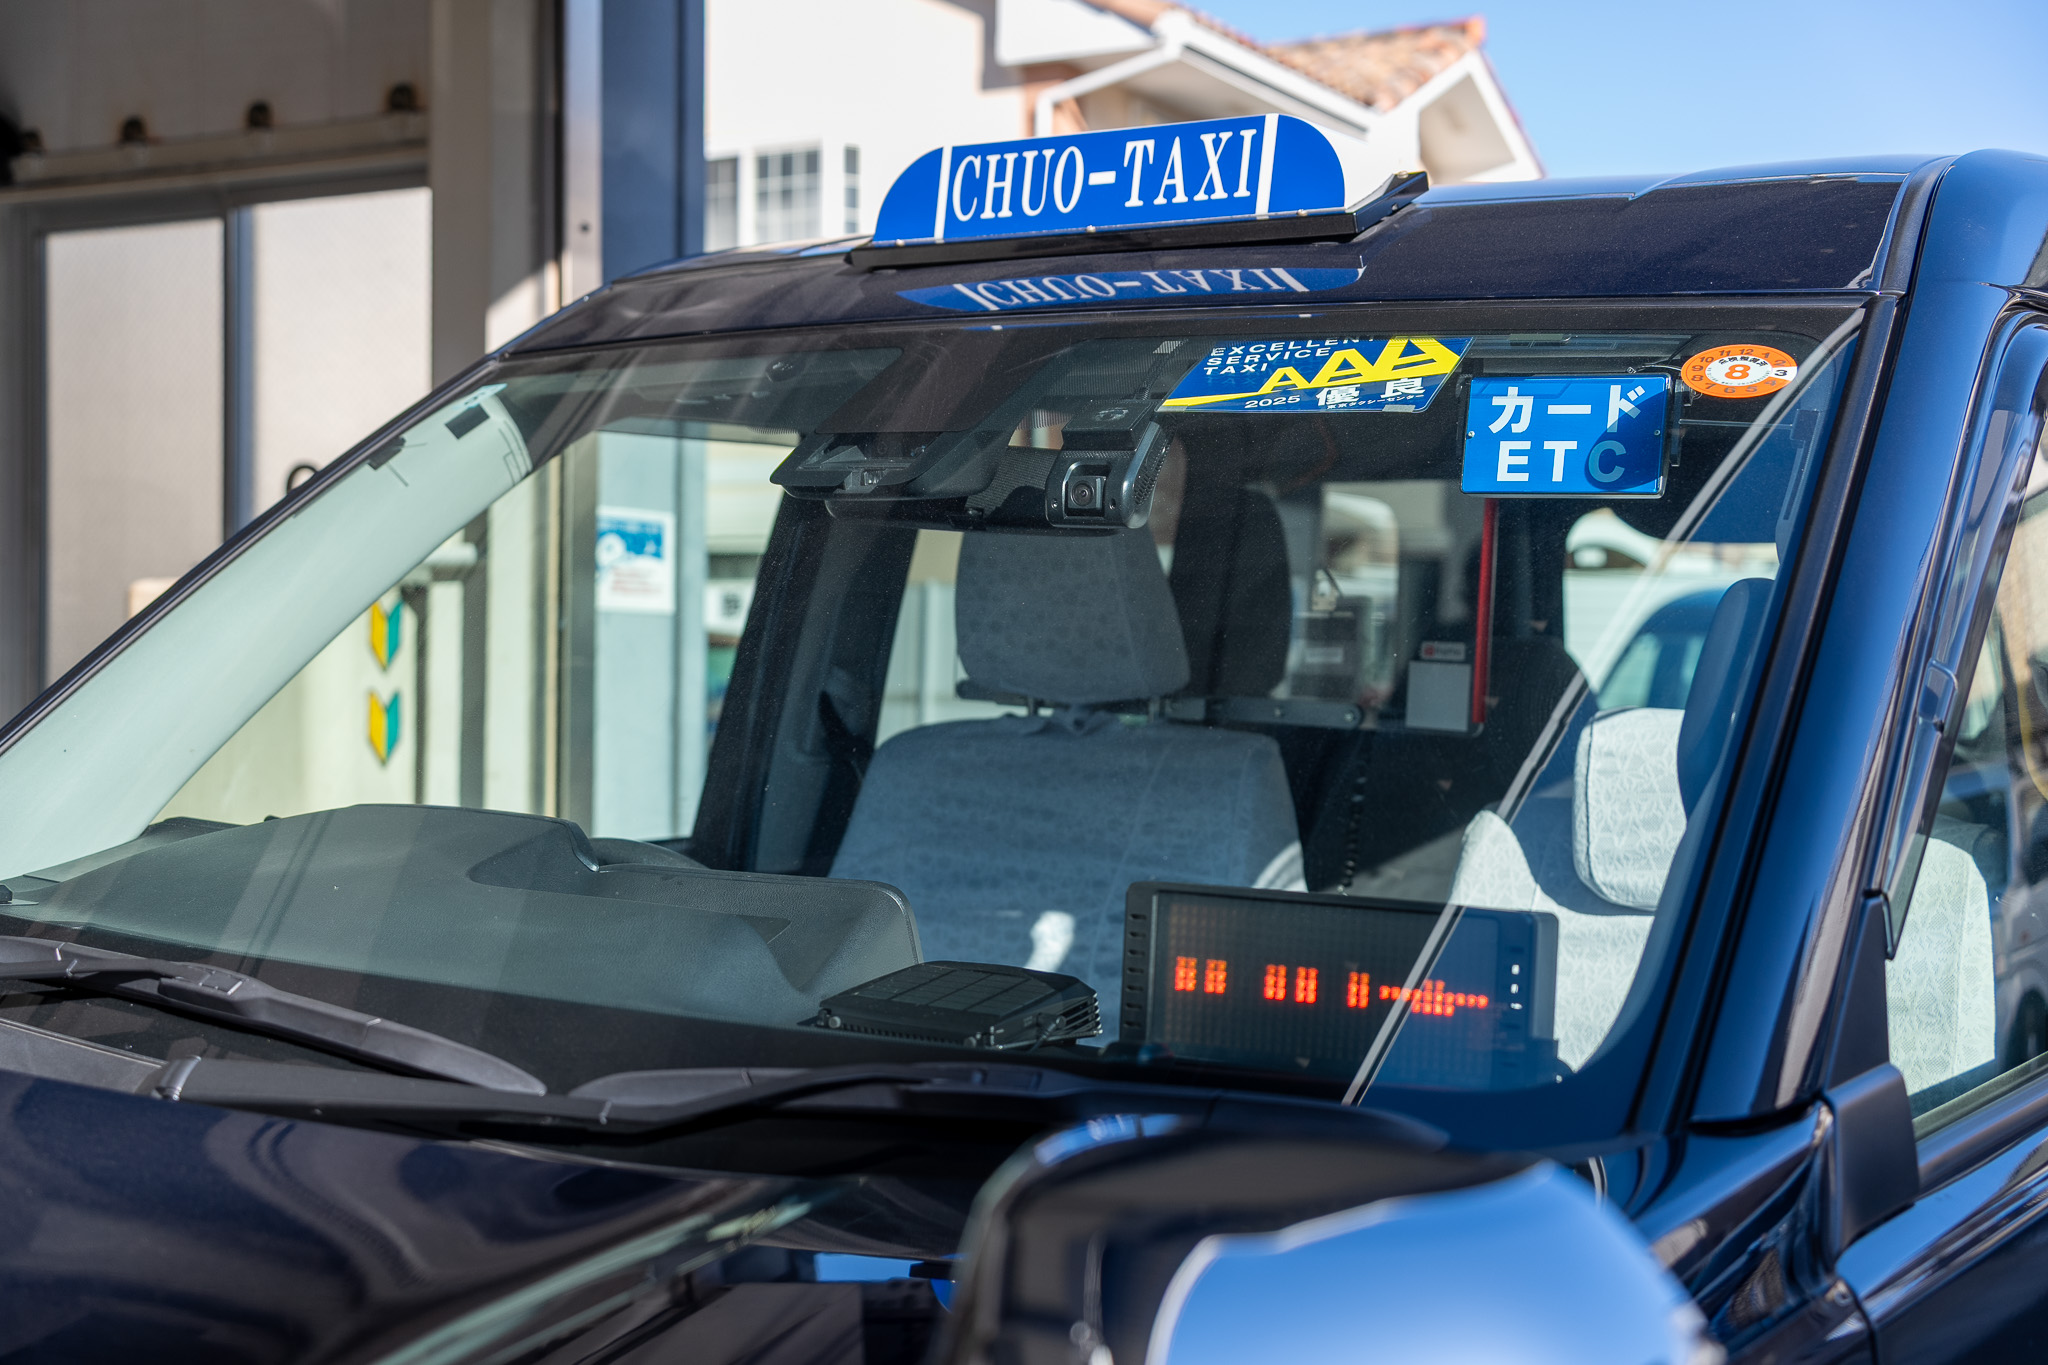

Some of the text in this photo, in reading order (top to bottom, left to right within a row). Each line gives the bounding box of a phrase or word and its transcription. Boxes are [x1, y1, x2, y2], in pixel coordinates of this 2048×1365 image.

[953, 128, 1257, 222] CHUO-TAXI
[1206, 347, 1331, 366] SERVICE
[1738, 348, 1754, 356] 12
[1203, 362, 1268, 375] TAXI
[1724, 364, 1751, 380] 8
[1774, 369, 1788, 377] 3
[1691, 374, 1704, 382] 8
[1764, 379, 1777, 387] 4
[1316, 377, 1425, 407] 優良
[1705, 382, 1717, 390] 7
[1724, 386, 1736, 394] 6
[1745, 385, 1758, 393] 5
[1245, 394, 1301, 409] 2025
[1488, 384, 1646, 434] カード
[1496, 440, 1627, 483] ETC
